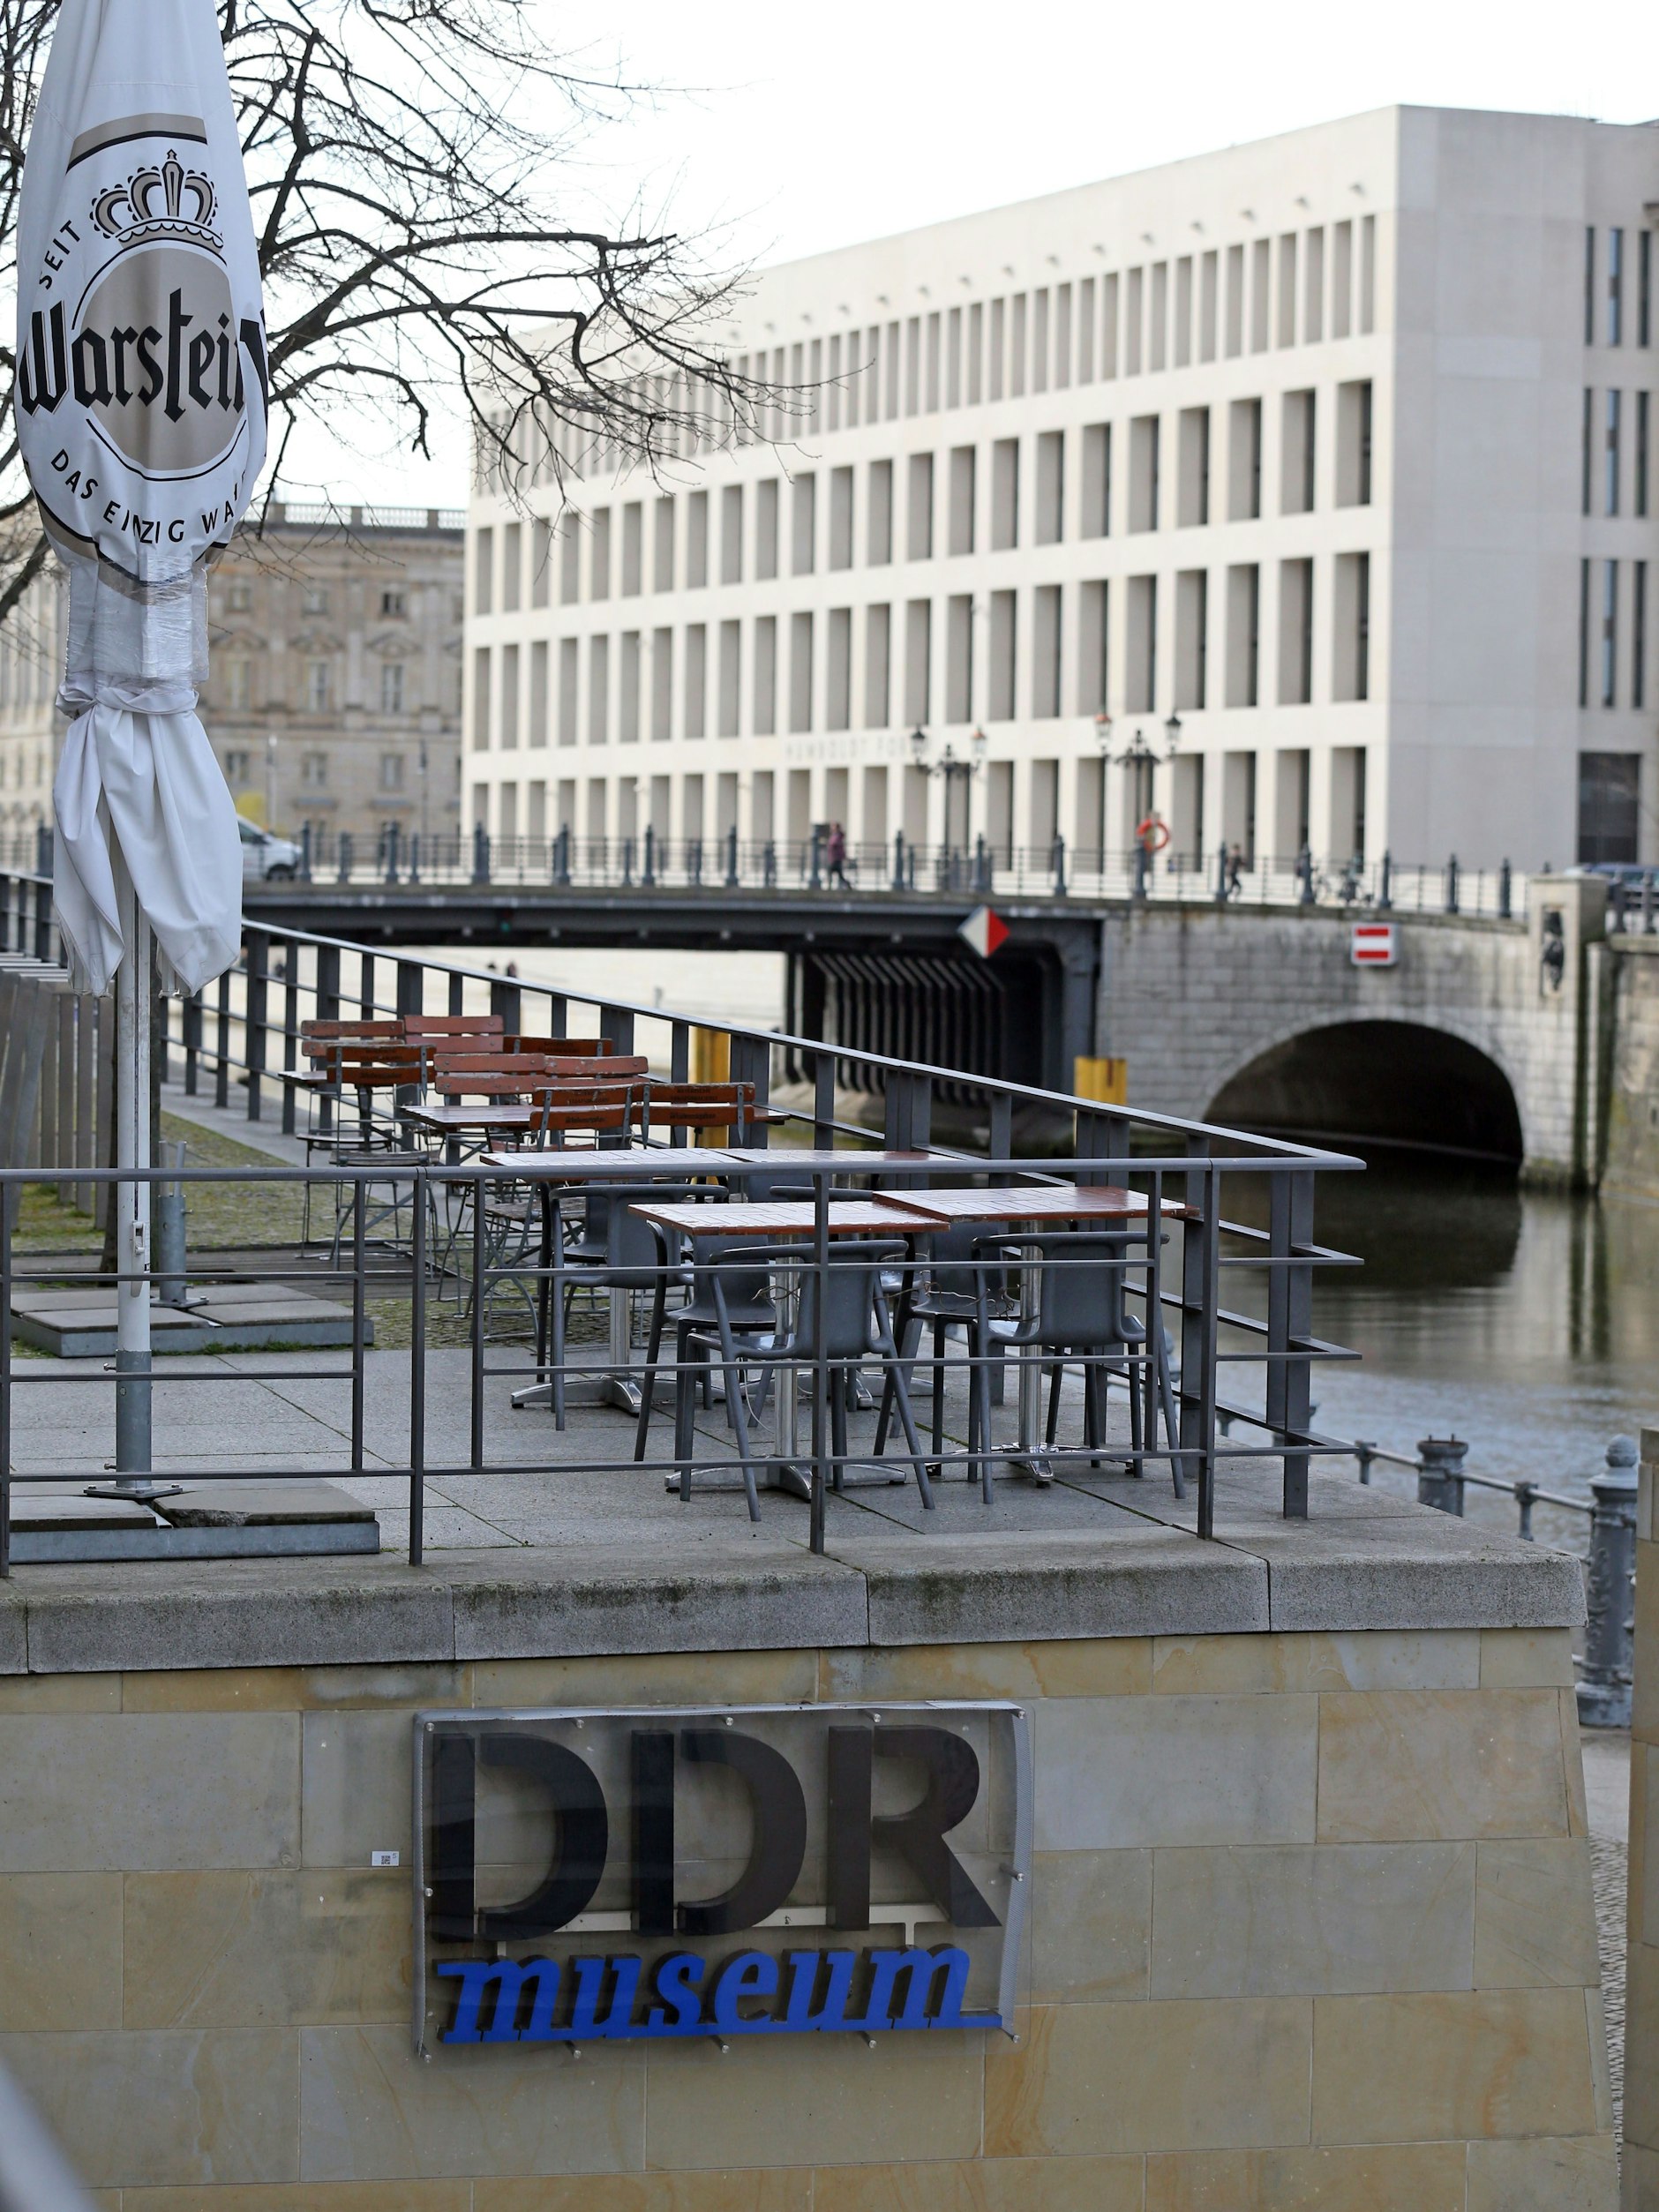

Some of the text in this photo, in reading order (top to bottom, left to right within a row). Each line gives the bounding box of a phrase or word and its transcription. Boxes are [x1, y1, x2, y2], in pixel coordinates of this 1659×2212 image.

[39, 220, 81, 290] SEIT
[50, 448, 99, 499] DAS
[432, 1724, 1002, 1941] DDR
[434, 1945, 1003, 2044] museum
